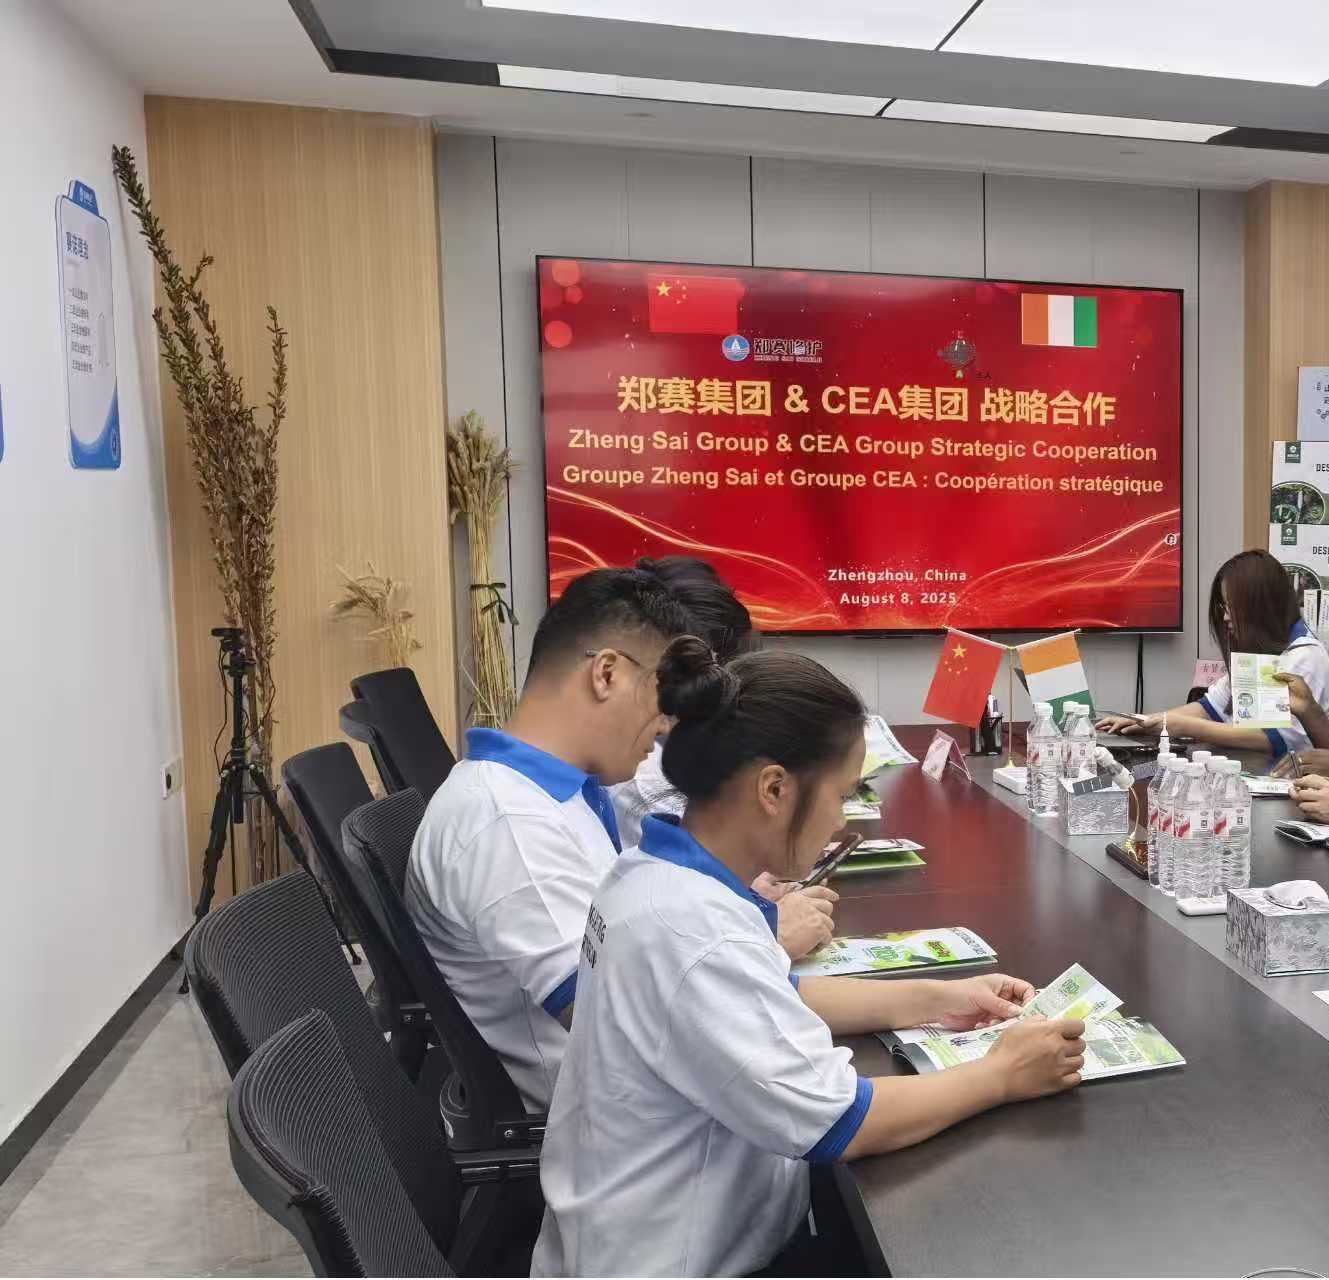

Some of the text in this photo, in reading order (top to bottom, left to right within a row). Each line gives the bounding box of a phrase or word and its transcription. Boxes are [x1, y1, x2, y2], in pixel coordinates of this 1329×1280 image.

[618, 376, 1117, 427] 郑赛集团 & CEA集团 战略合作
[568, 429, 1157, 463] Zheng Sai Group & CEA Group Strategic Cooperation
[563, 465, 1164, 496] Groupe Zheng Sai et Groupe CEA : Coopération stratégique
[828, 569, 967, 584] Zhengzhou, China
[840, 592, 957, 607] August 8, 2025
